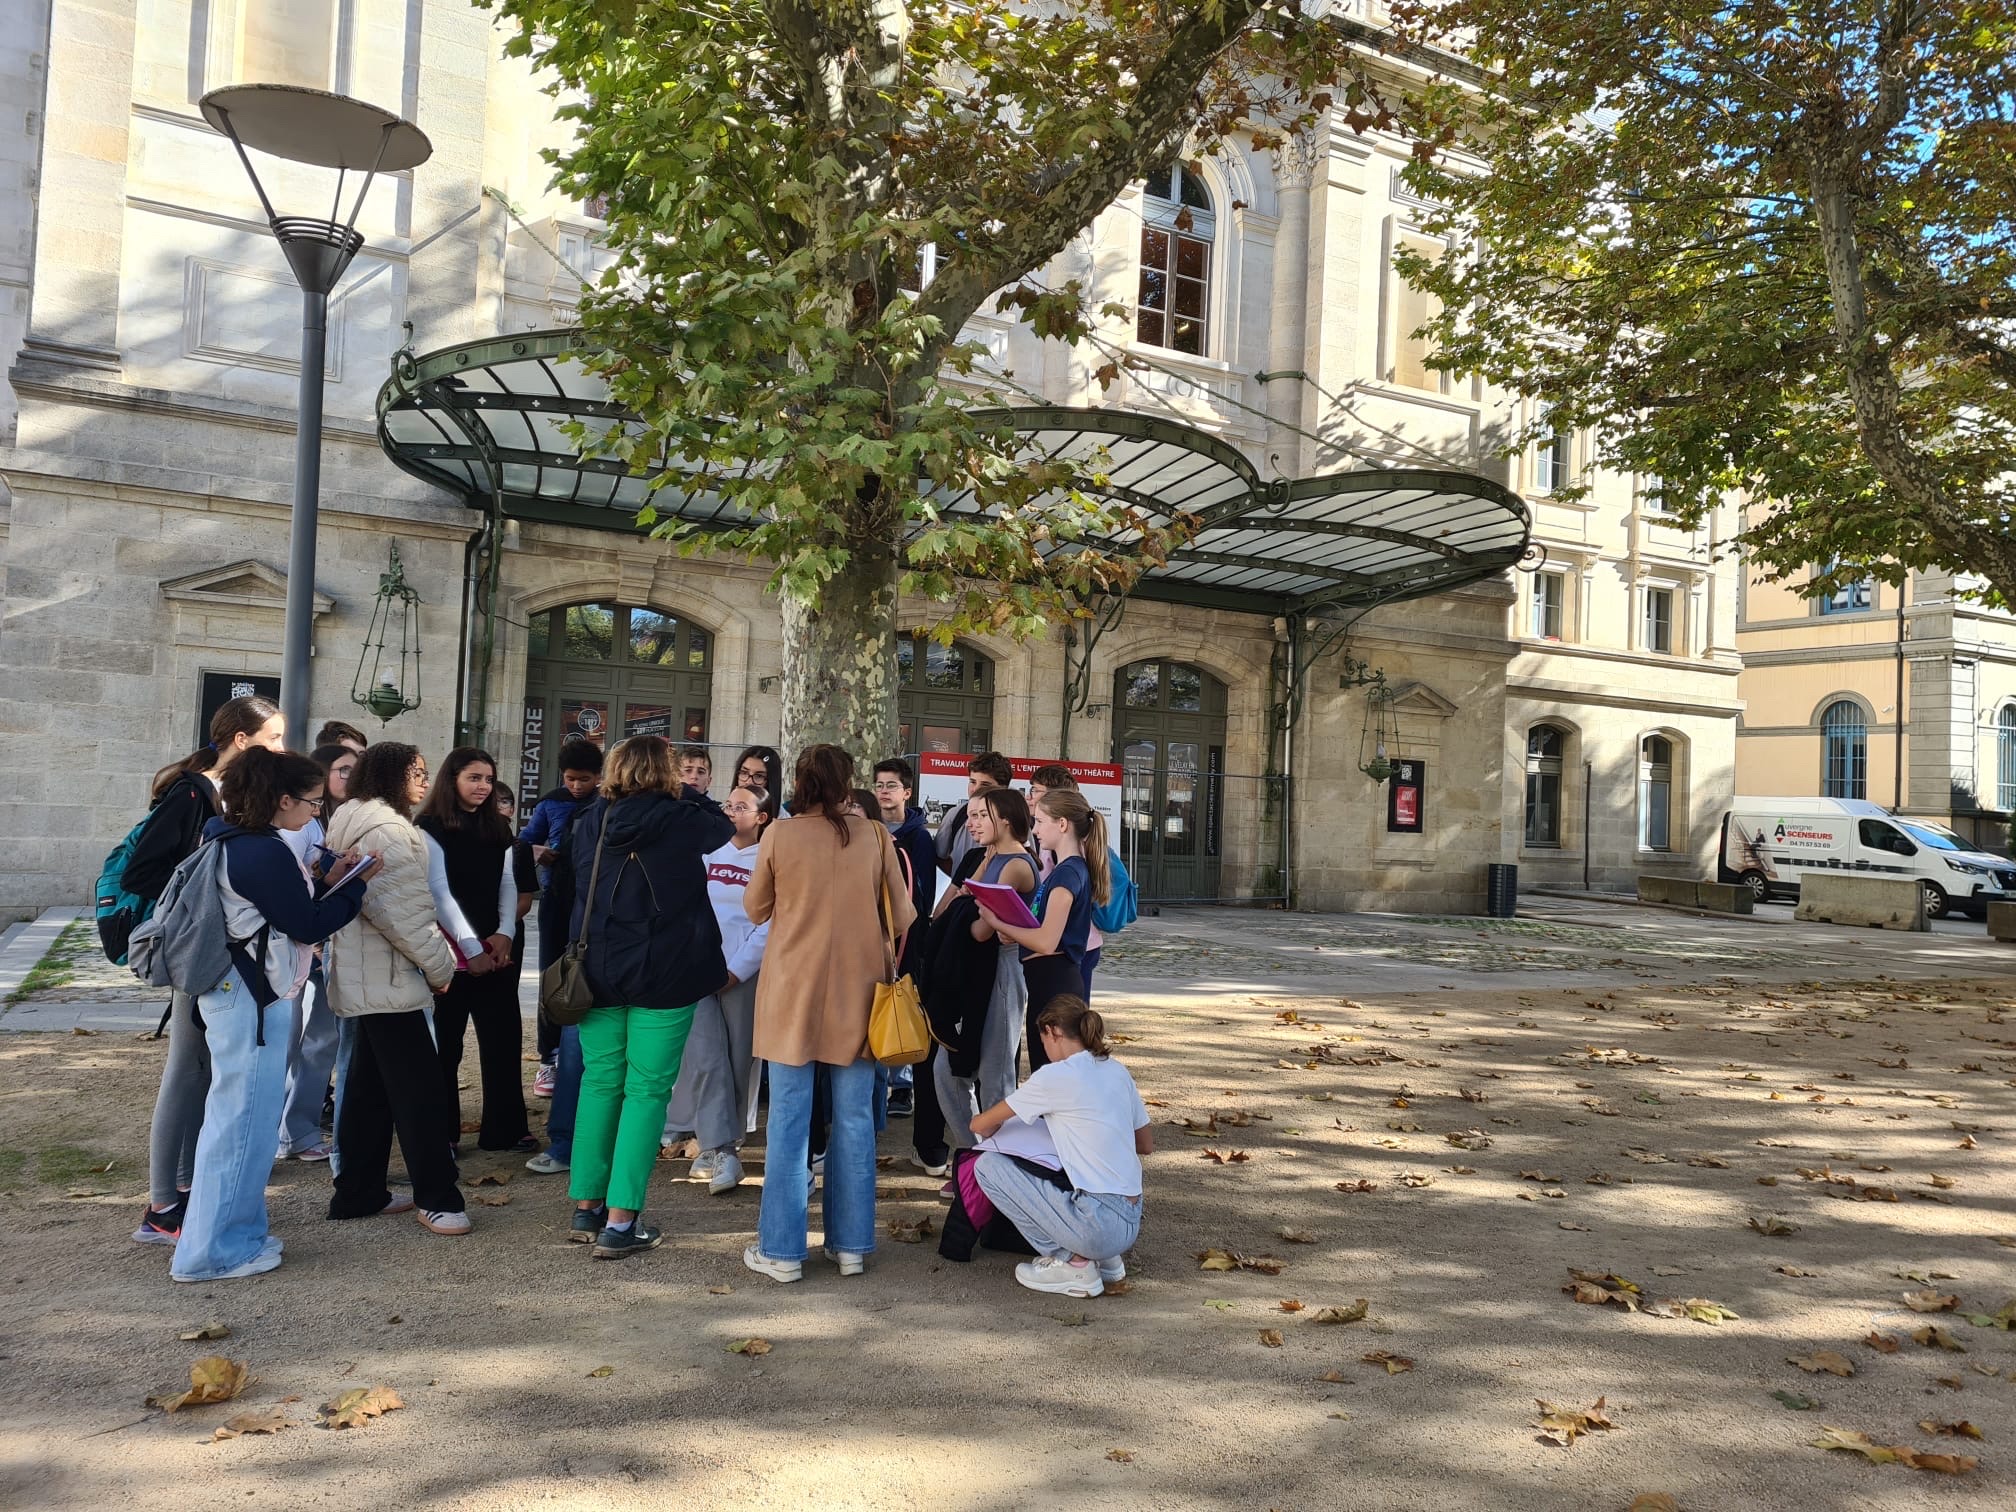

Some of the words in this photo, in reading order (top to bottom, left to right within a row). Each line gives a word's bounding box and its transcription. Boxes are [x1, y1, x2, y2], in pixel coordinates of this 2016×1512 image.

[521, 708, 543, 802] THÉÂTRE
[930, 758, 965, 768] TRAVAUX
[1084, 768, 1115, 778] THÉÂTRE
